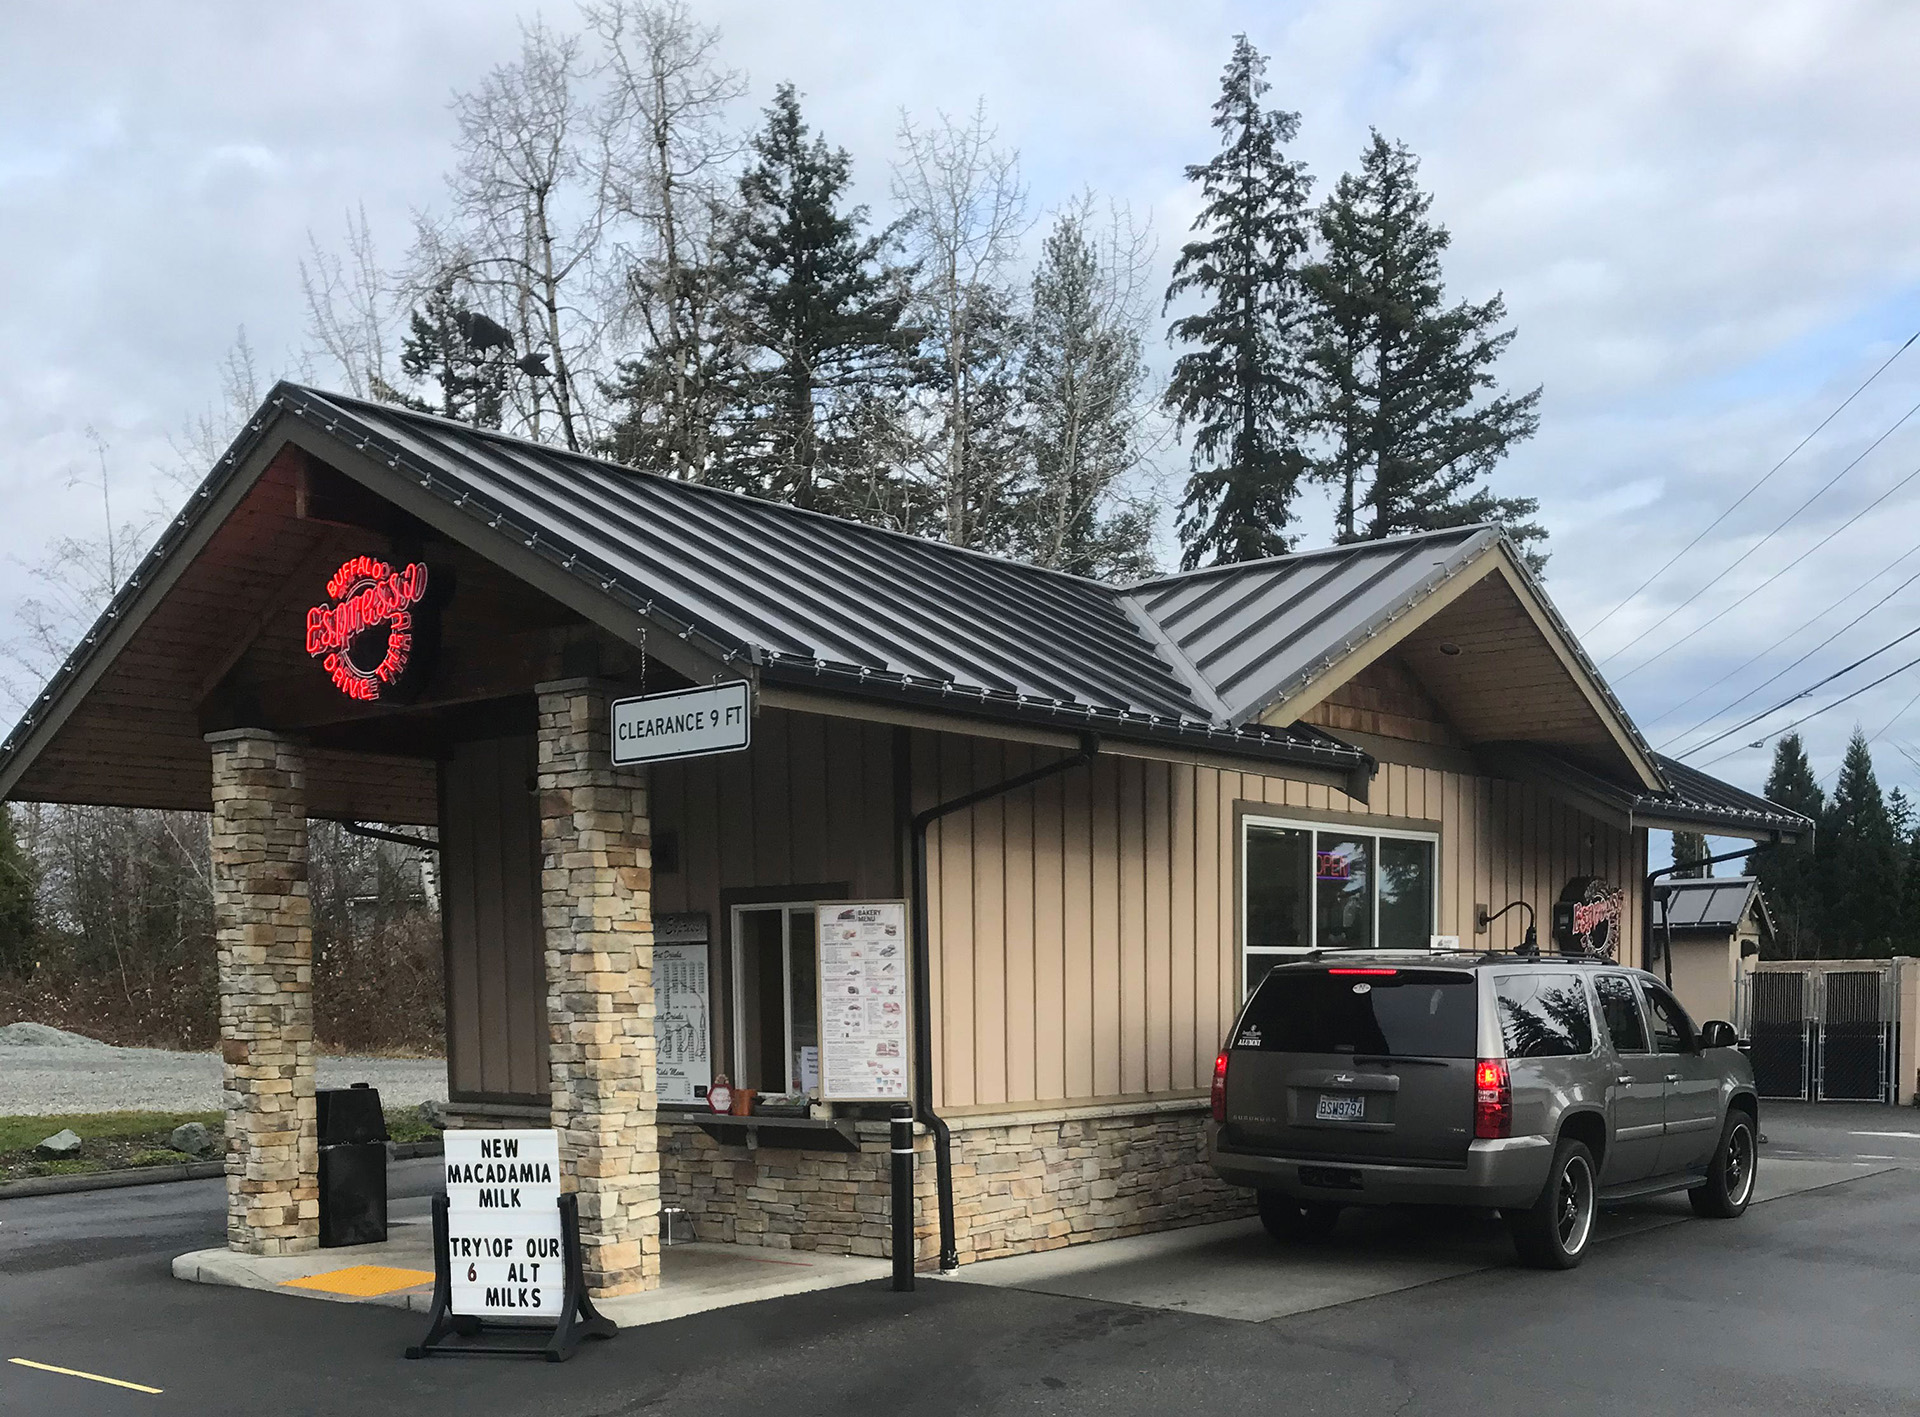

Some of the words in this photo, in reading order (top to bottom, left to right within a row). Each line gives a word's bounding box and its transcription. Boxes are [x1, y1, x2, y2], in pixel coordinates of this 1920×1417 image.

[327, 555, 384, 598] BUFFALO
[306, 562, 418, 653] Espresso
[324, 652, 374, 700] DRIVE
[618, 711, 704, 741] CLEARANCE
[710, 709, 719, 727] 9
[725, 705, 742, 726] FT
[1316, 854, 1349, 877] OPEN
[857, 909, 882, 917] BAKERY
[857, 915, 876, 923] MENU
[1320, 1101, 1363, 1116] BSW9794
[481, 1138, 519, 1159] NEW
[447, 1163, 552, 1184] MACADAMIA
[478, 1188, 522, 1208] MILK
[526, 1238, 560, 1258] OUR
[467, 1262, 477, 1282] 6
[507, 1262, 541, 1283] ALT
[485, 1287, 541, 1308] MILKS
